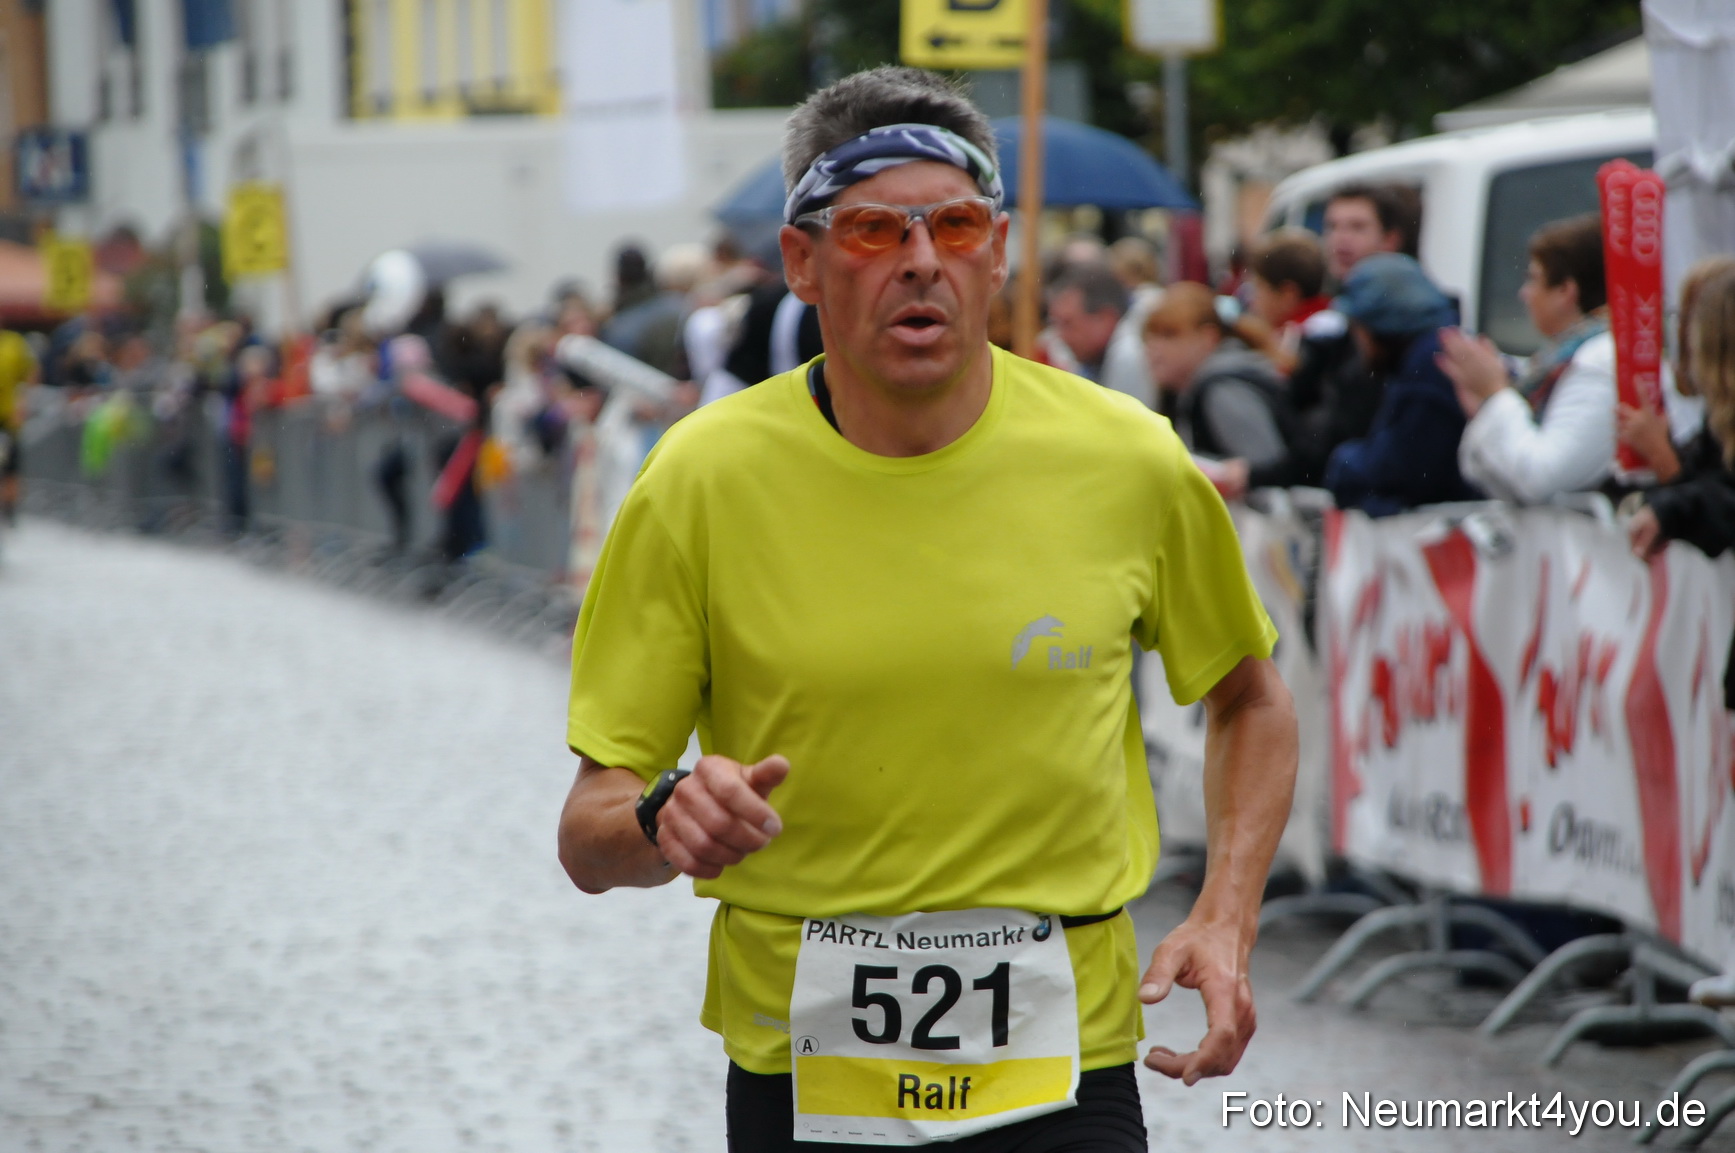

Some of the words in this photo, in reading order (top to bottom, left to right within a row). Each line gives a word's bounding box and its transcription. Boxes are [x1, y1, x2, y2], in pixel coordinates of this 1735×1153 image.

[1047, 645, 1094, 670] Ralf
[806, 919, 889, 949] PARTL
[897, 925, 1025, 950] Neumarkt
[850, 961, 1011, 1051] 521
[802, 1038, 813, 1053] A
[897, 1073, 971, 1111] Ralf
